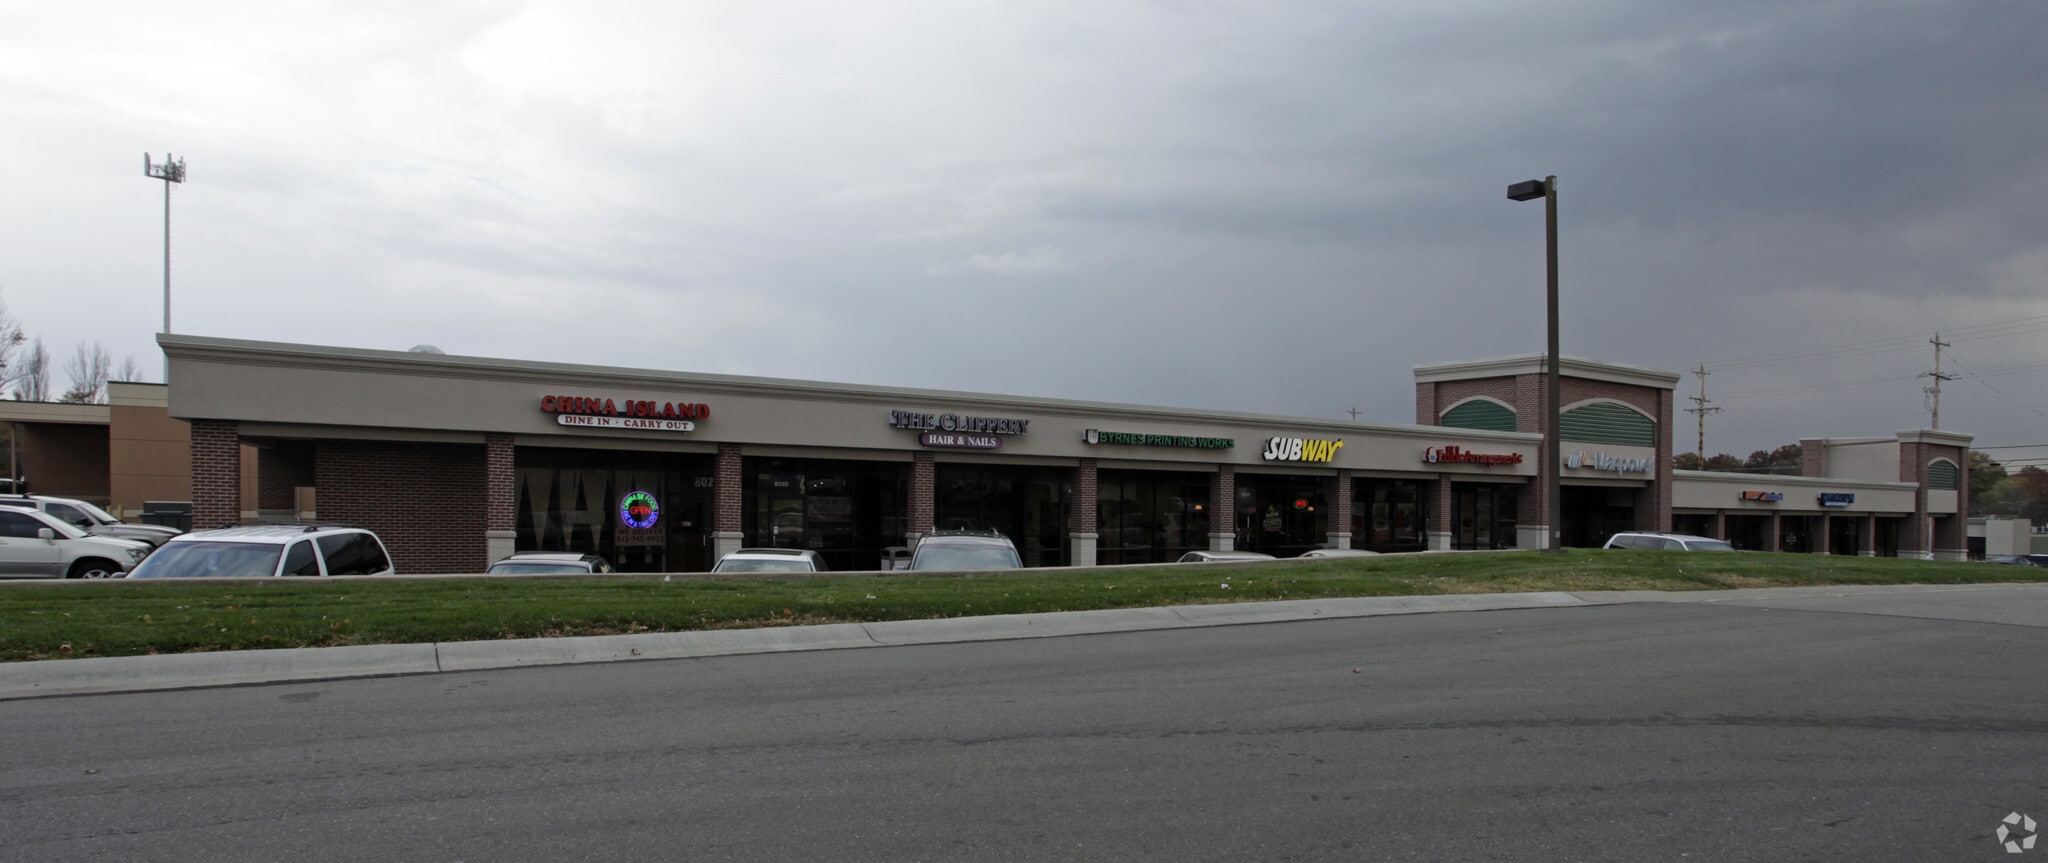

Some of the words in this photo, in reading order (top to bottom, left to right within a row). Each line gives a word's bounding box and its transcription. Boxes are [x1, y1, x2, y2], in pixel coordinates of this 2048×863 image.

[541, 395, 617, 415] CHINA
[625, 399, 711, 419] ISLAND
[565, 416, 593, 425] DINE
[598, 417, 610, 425] IN
[624, 419, 661, 428] CARRY
[666, 421, 689, 430] OUT
[891, 410, 935, 429] THE
[940, 413, 1030, 434] CLIPPERY
[929, 435, 954, 445] HAIR
[957, 436, 964, 445] &
[968, 437, 996, 446] NAILS
[1100, 432, 1145, 445] BYRNES
[1146, 434, 1196, 447] PRINTING
[1196, 437, 1235, 448] WORKS
[1264, 437, 1344, 462] SUBWAY
[630, 506, 651, 514] OPEN
